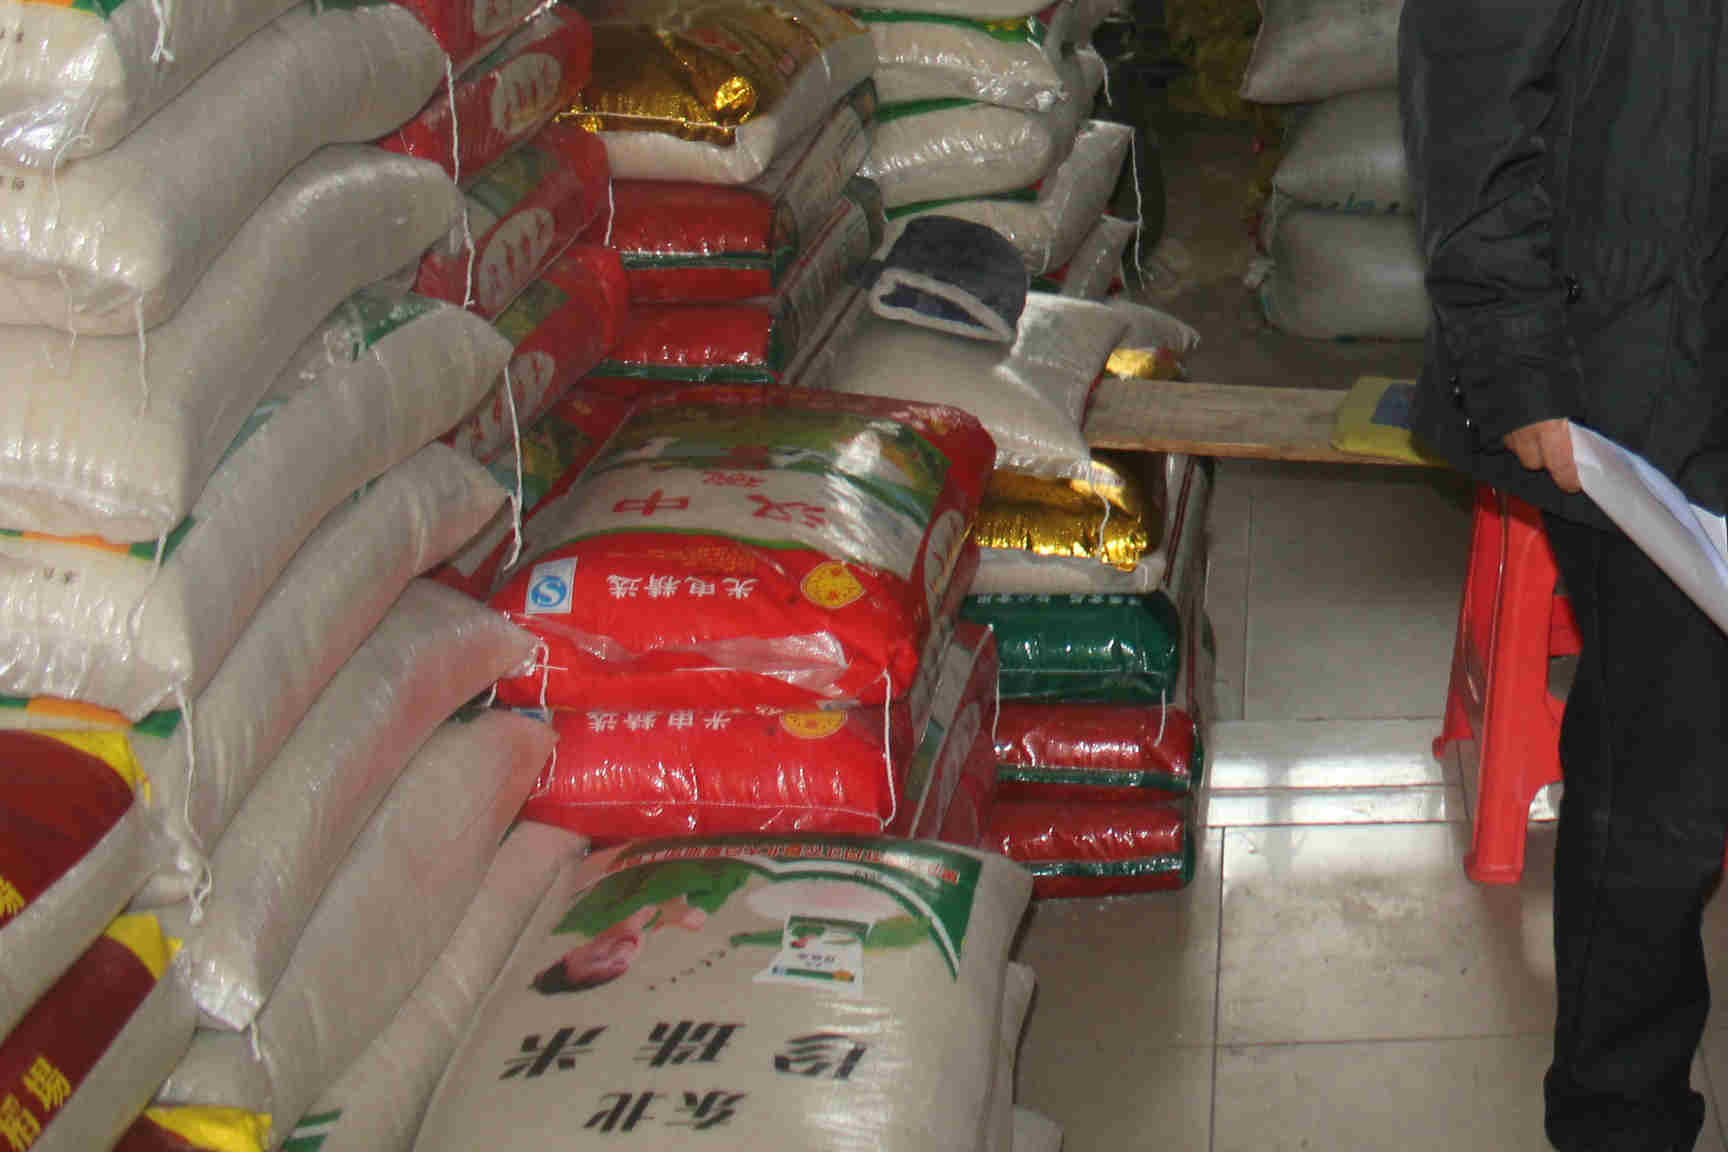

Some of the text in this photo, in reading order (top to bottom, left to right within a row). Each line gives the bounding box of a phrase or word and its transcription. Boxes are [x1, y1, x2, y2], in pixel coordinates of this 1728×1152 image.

[611, 486, 828, 530] 汉中
[606, 570, 761, 601] 光电精选
[499, 1019, 868, 1081] 珍珠米
[583, 1089, 750, 1133] 东北
